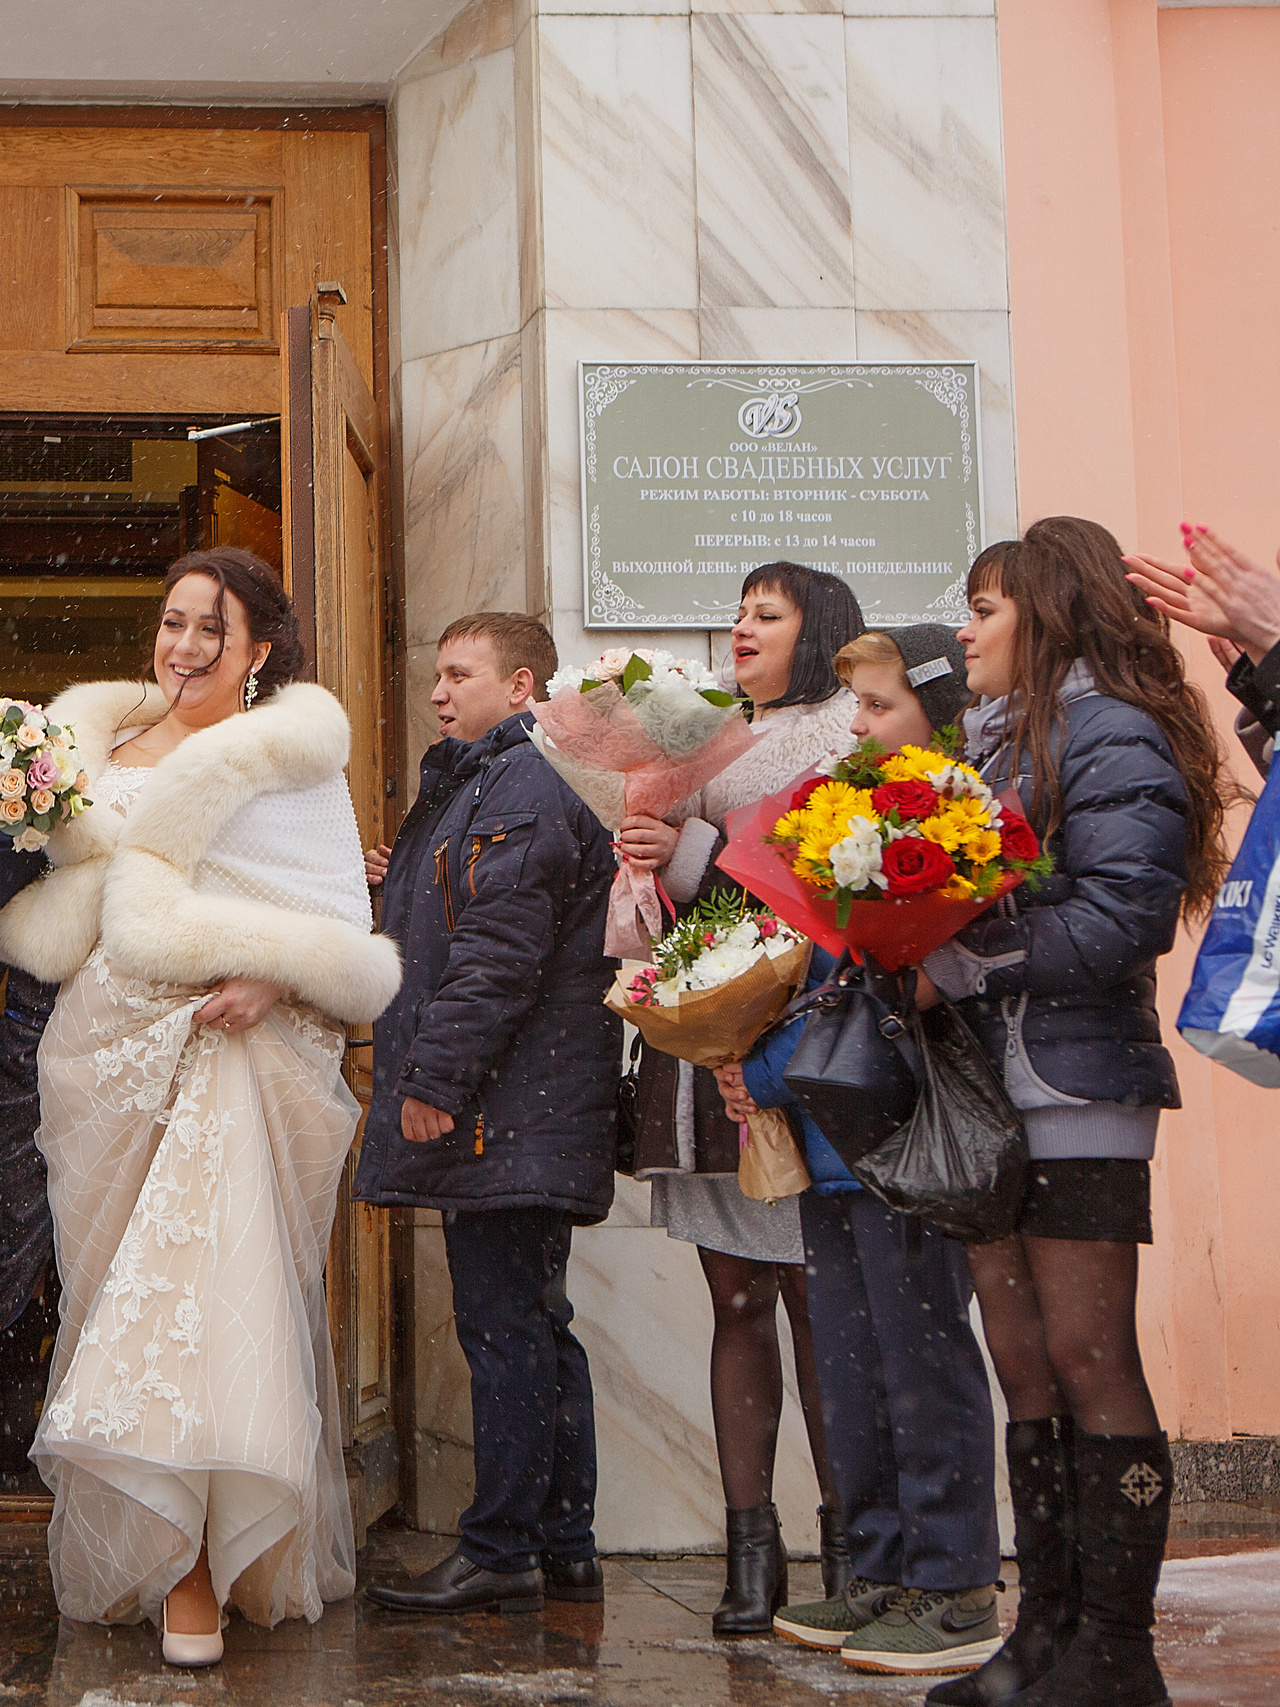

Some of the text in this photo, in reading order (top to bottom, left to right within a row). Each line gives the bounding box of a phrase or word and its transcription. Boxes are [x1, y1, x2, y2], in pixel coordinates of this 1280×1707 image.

[729, 442, 818, 453] ООО «ВЕЛАН»
[613, 456, 953, 485] САЛОН СВАДЕБНЫХ УСЛУГ
[640, 489, 699, 501] РЕЖИМ
[703, 489, 770, 501] РАБОТЫ:
[773, 489, 848, 501] ВТОРНИК
[859, 489, 931, 501] СУББОТА
[730, 510, 833, 523] с 10 до 18 часов
[694, 534, 877, 548] ПЕРЕРЫВ: с 13 до 14 часов
[612, 559, 694, 575] ВЫХОДНОЙ
[696, 561, 738, 575] ДЕНЬ:
[846, 561, 954, 576] ПОНЕДЕЛЬНИК
